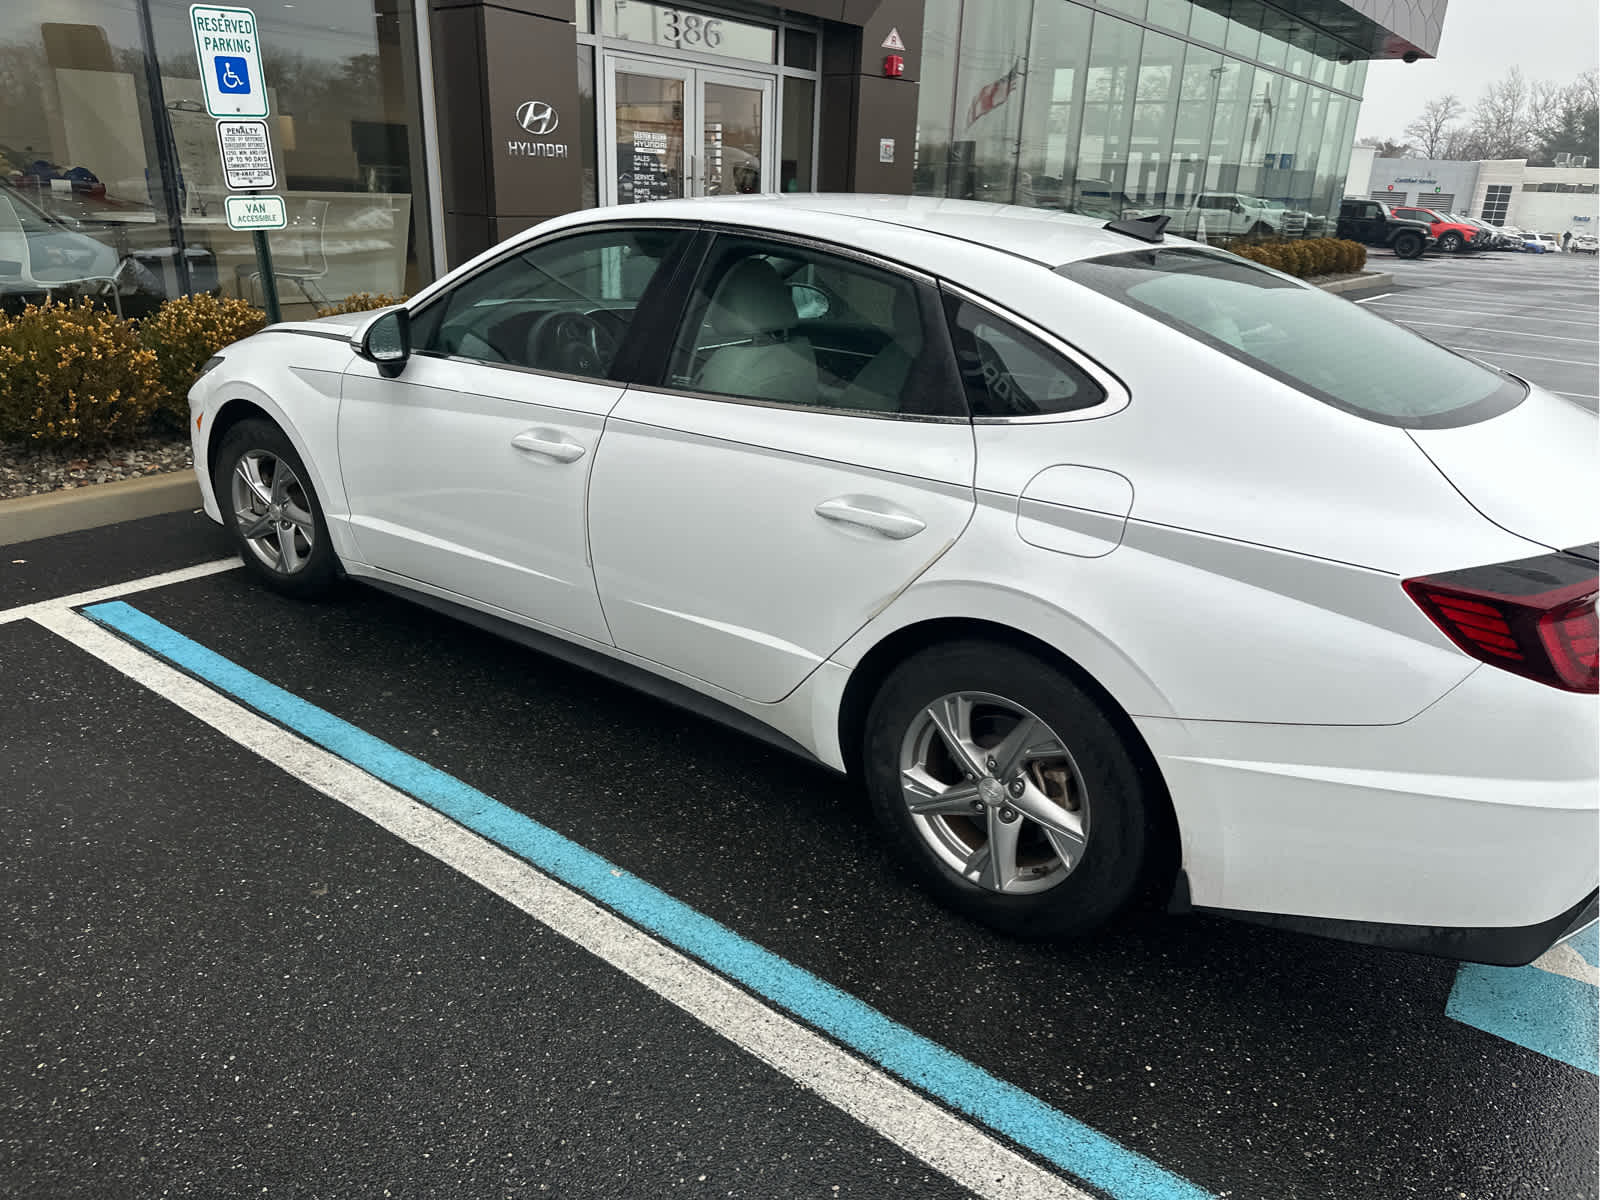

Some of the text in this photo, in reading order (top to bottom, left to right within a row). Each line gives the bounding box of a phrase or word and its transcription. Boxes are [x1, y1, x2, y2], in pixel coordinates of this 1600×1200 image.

[197, 17, 252, 34] RESERVED
[664, 10, 721, 48] 386
[204, 37, 251, 53] PARKING
[226, 127, 258, 135] PENALTY
[508, 141, 568, 158] HYUNDAI
[634, 140, 667, 148] HYUNDAI
[245, 203, 266, 214] VAN
[238, 214, 277, 223] ACCESSIBLE
